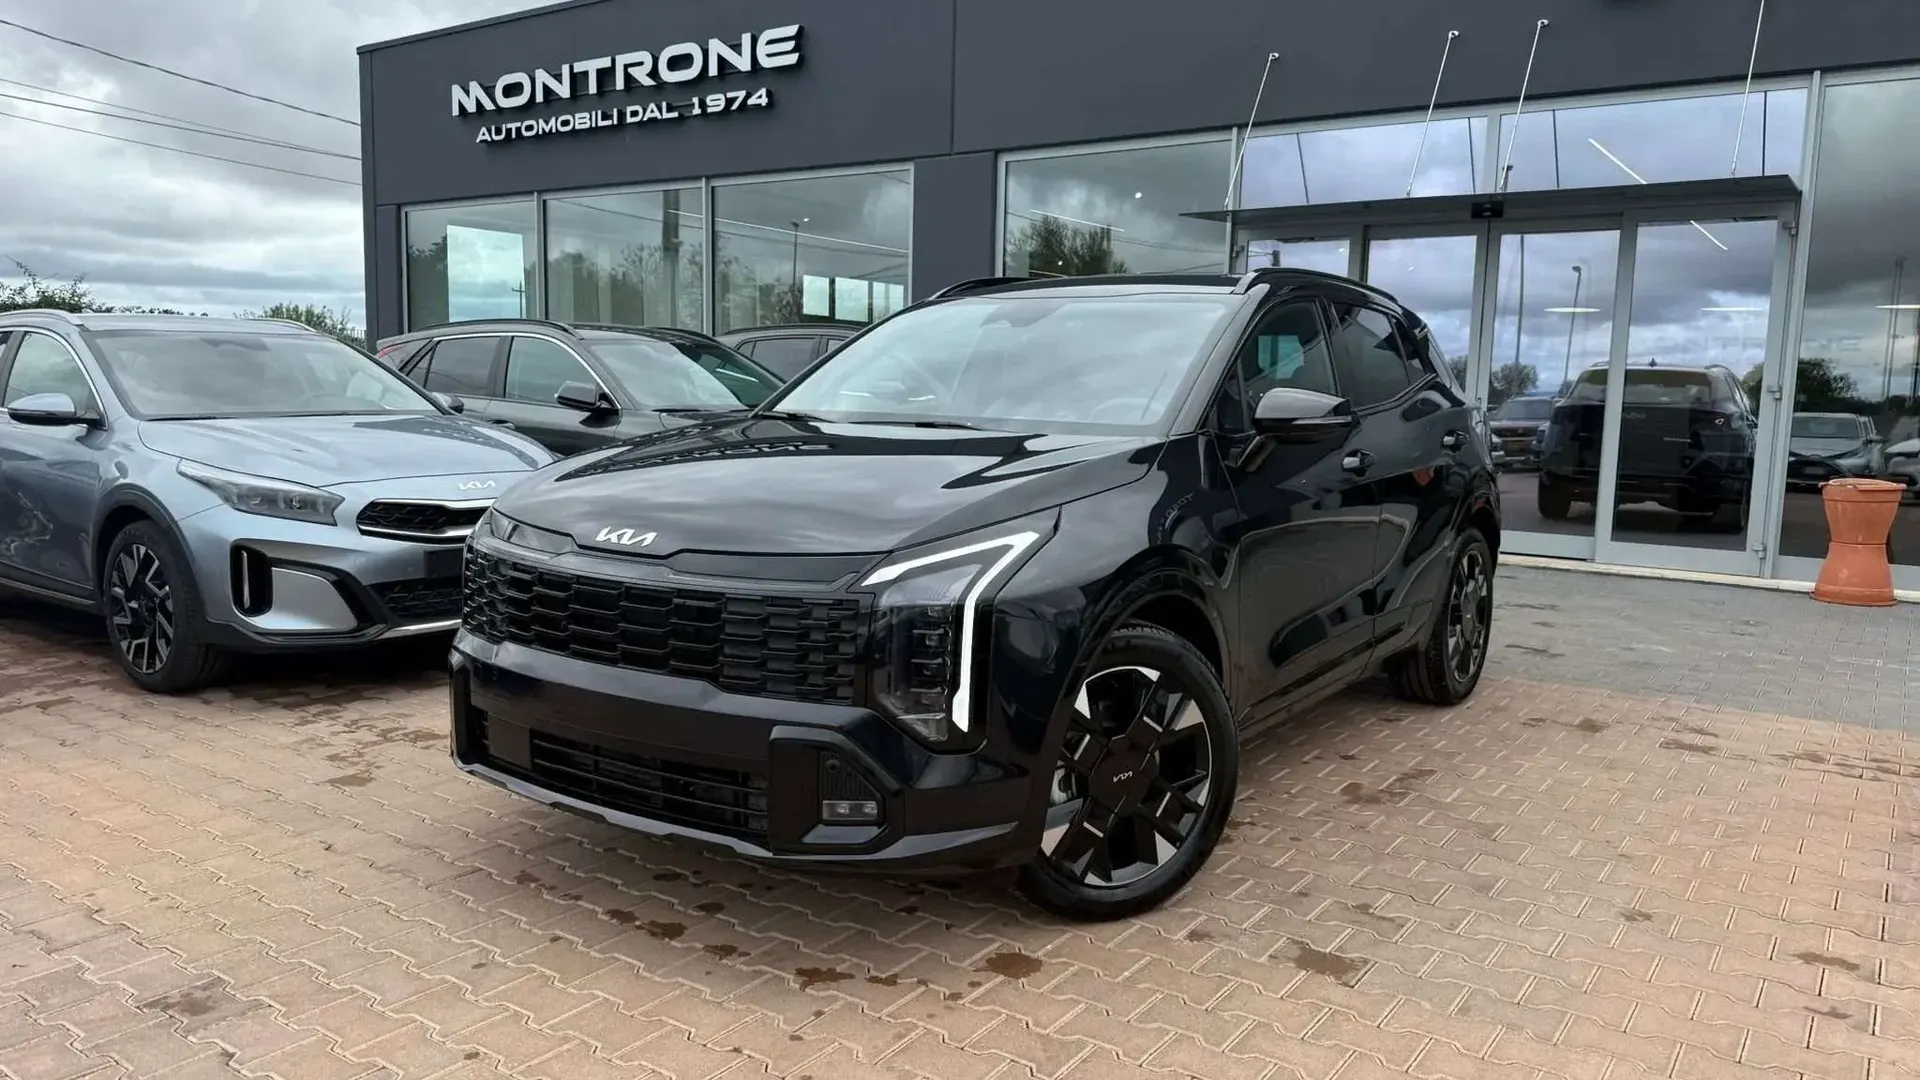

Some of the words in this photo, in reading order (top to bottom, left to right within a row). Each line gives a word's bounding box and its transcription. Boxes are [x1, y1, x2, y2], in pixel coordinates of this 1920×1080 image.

[451, 24, 800, 117] MONTRONE
[476, 108, 618, 143] AUTOMOBILI
[626, 101, 679, 124] DAL
[692, 87, 769, 115] 1974
[595, 526, 658, 547] KIA
